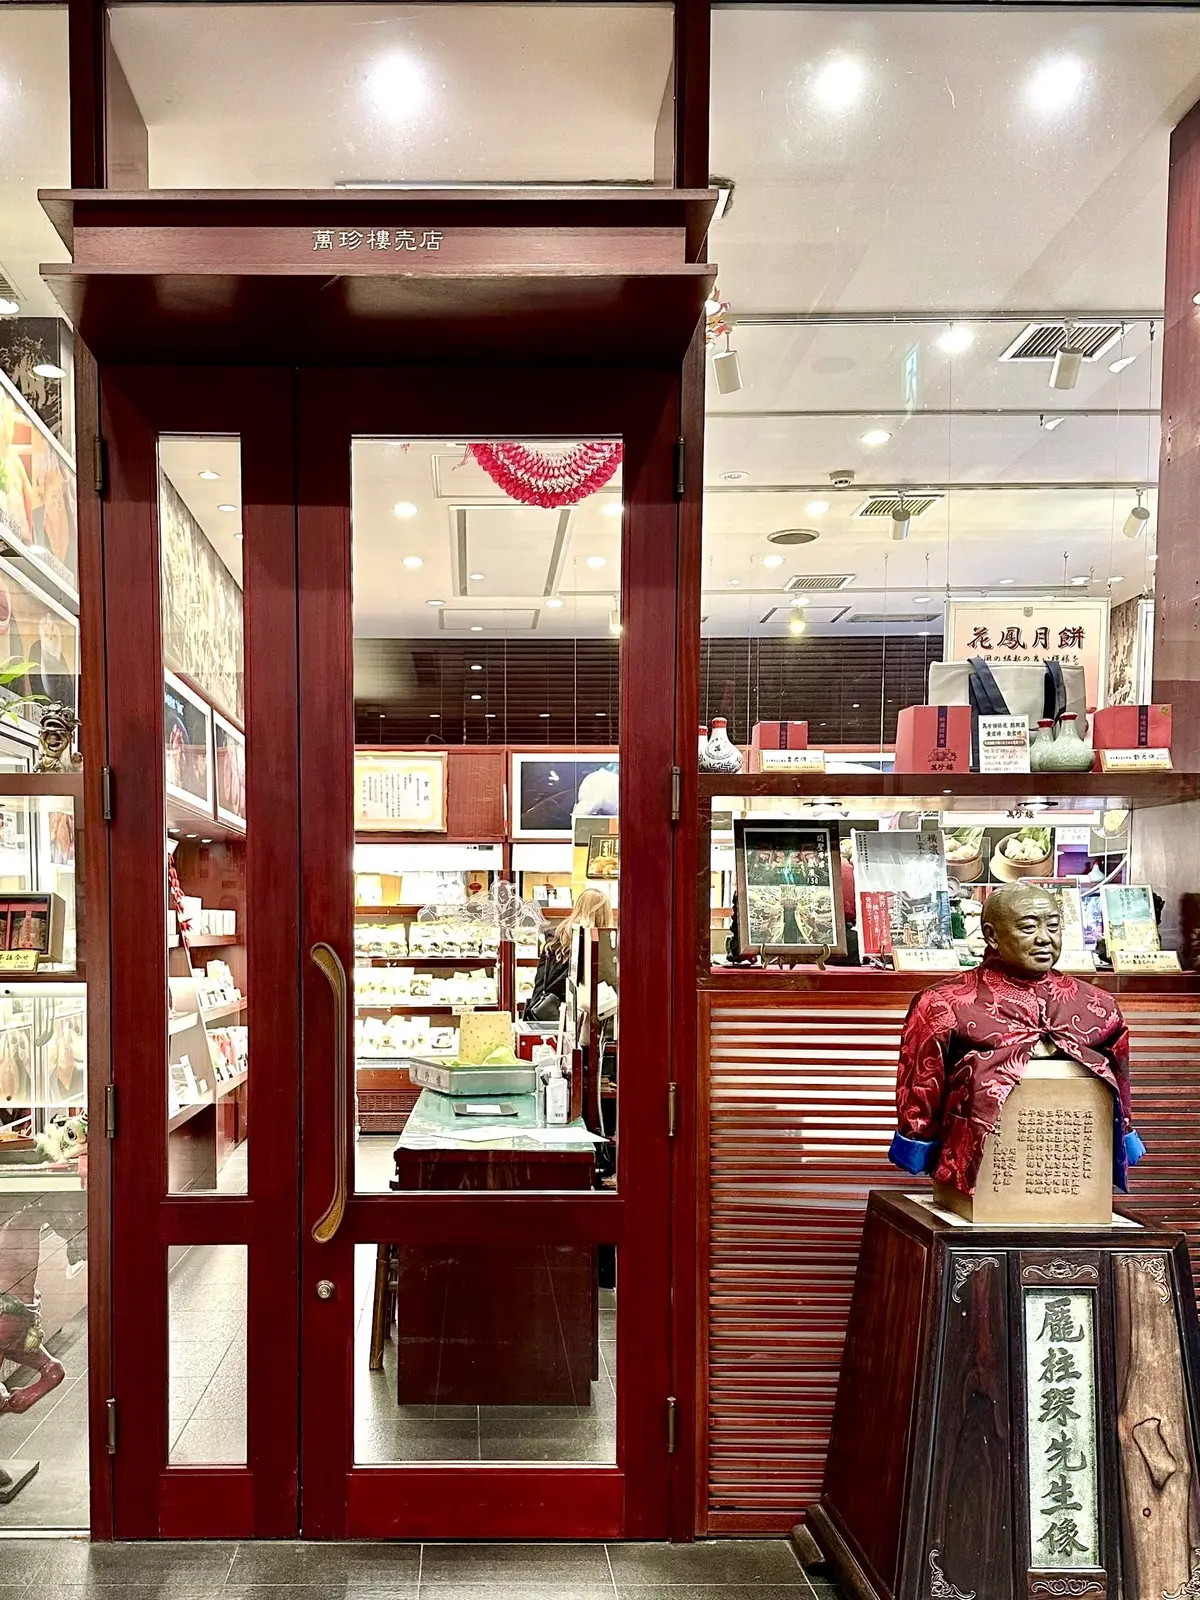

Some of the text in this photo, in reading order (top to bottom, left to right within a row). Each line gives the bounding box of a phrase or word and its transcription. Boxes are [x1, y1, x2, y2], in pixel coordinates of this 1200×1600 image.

[312, 229, 443, 250] 萬珍樓売店
[967, 626, 1086, 650] 花鳳月餅
